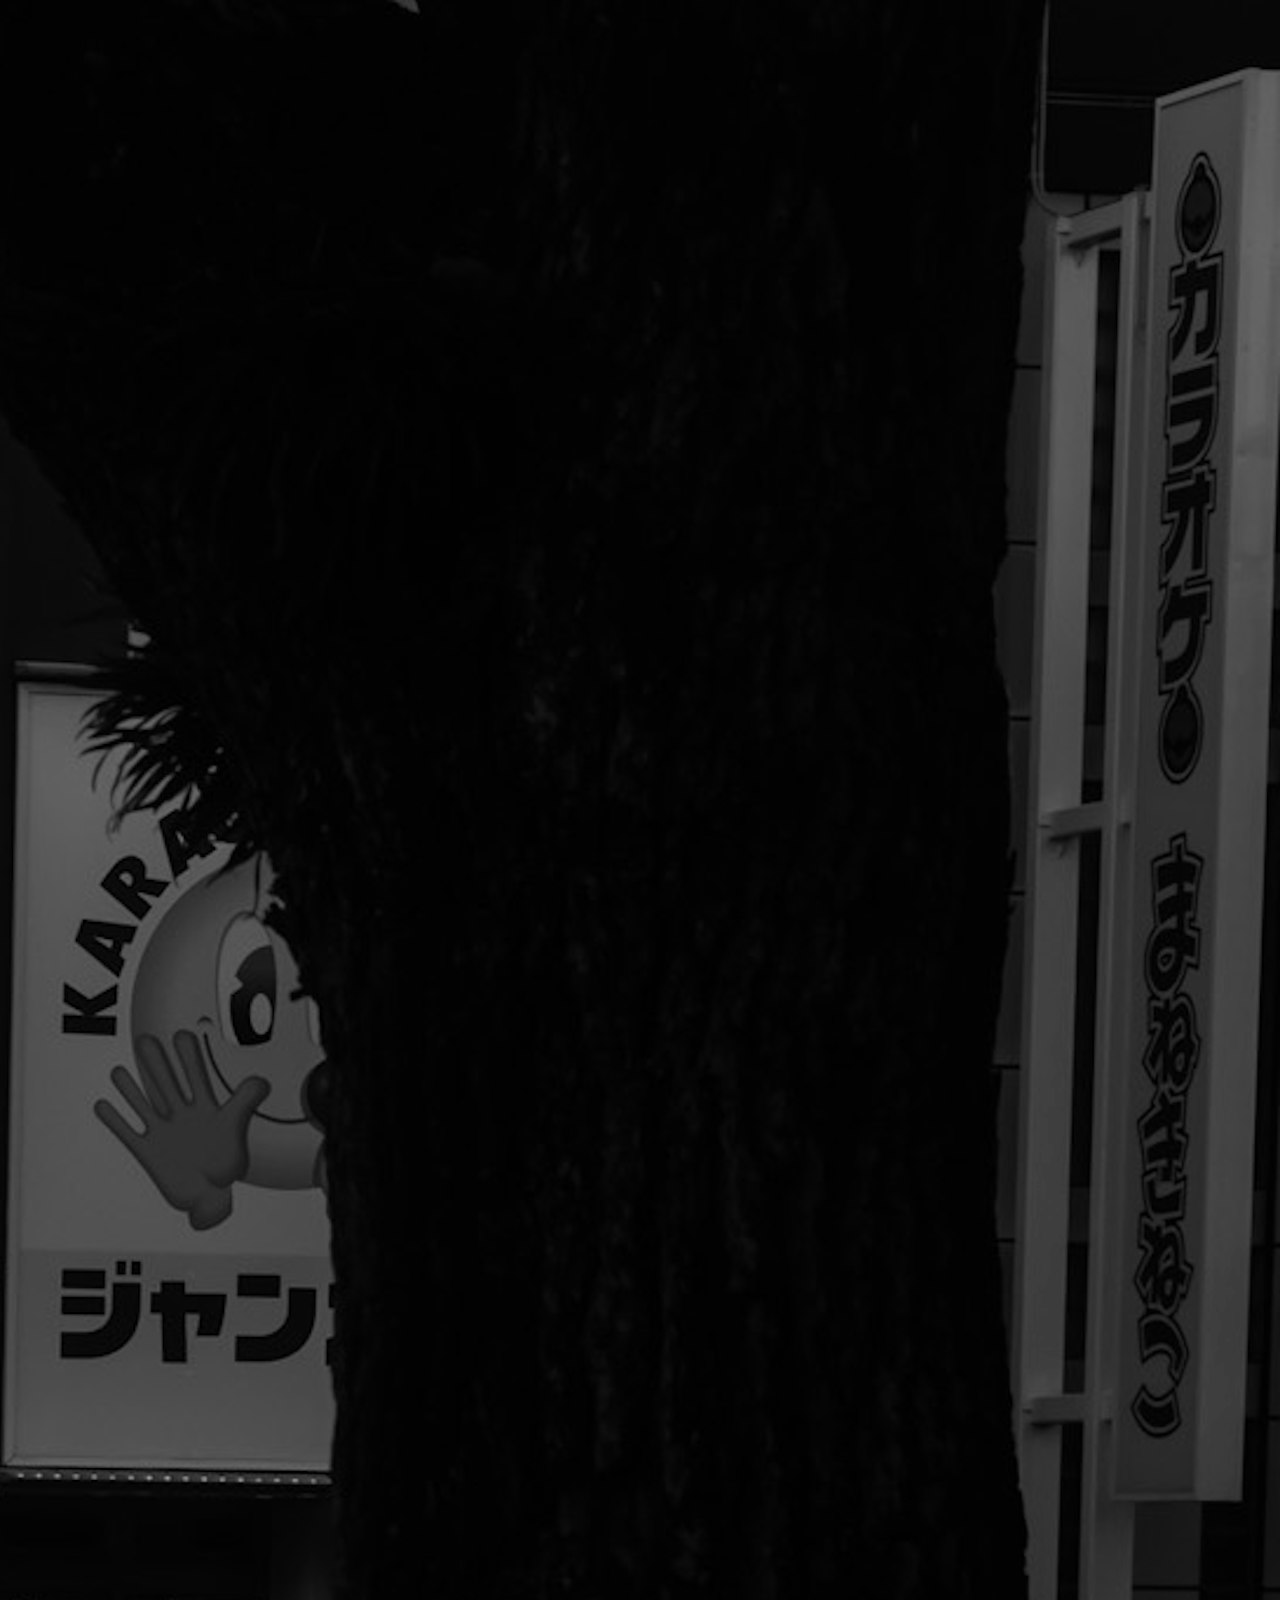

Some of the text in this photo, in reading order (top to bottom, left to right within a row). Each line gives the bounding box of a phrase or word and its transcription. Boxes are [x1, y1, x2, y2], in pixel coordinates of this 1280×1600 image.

[1156, 252, 1223, 694] カラオケ
[62, 808, 230, 1035] KARA
[61, 1261, 334, 1364] ジャン
